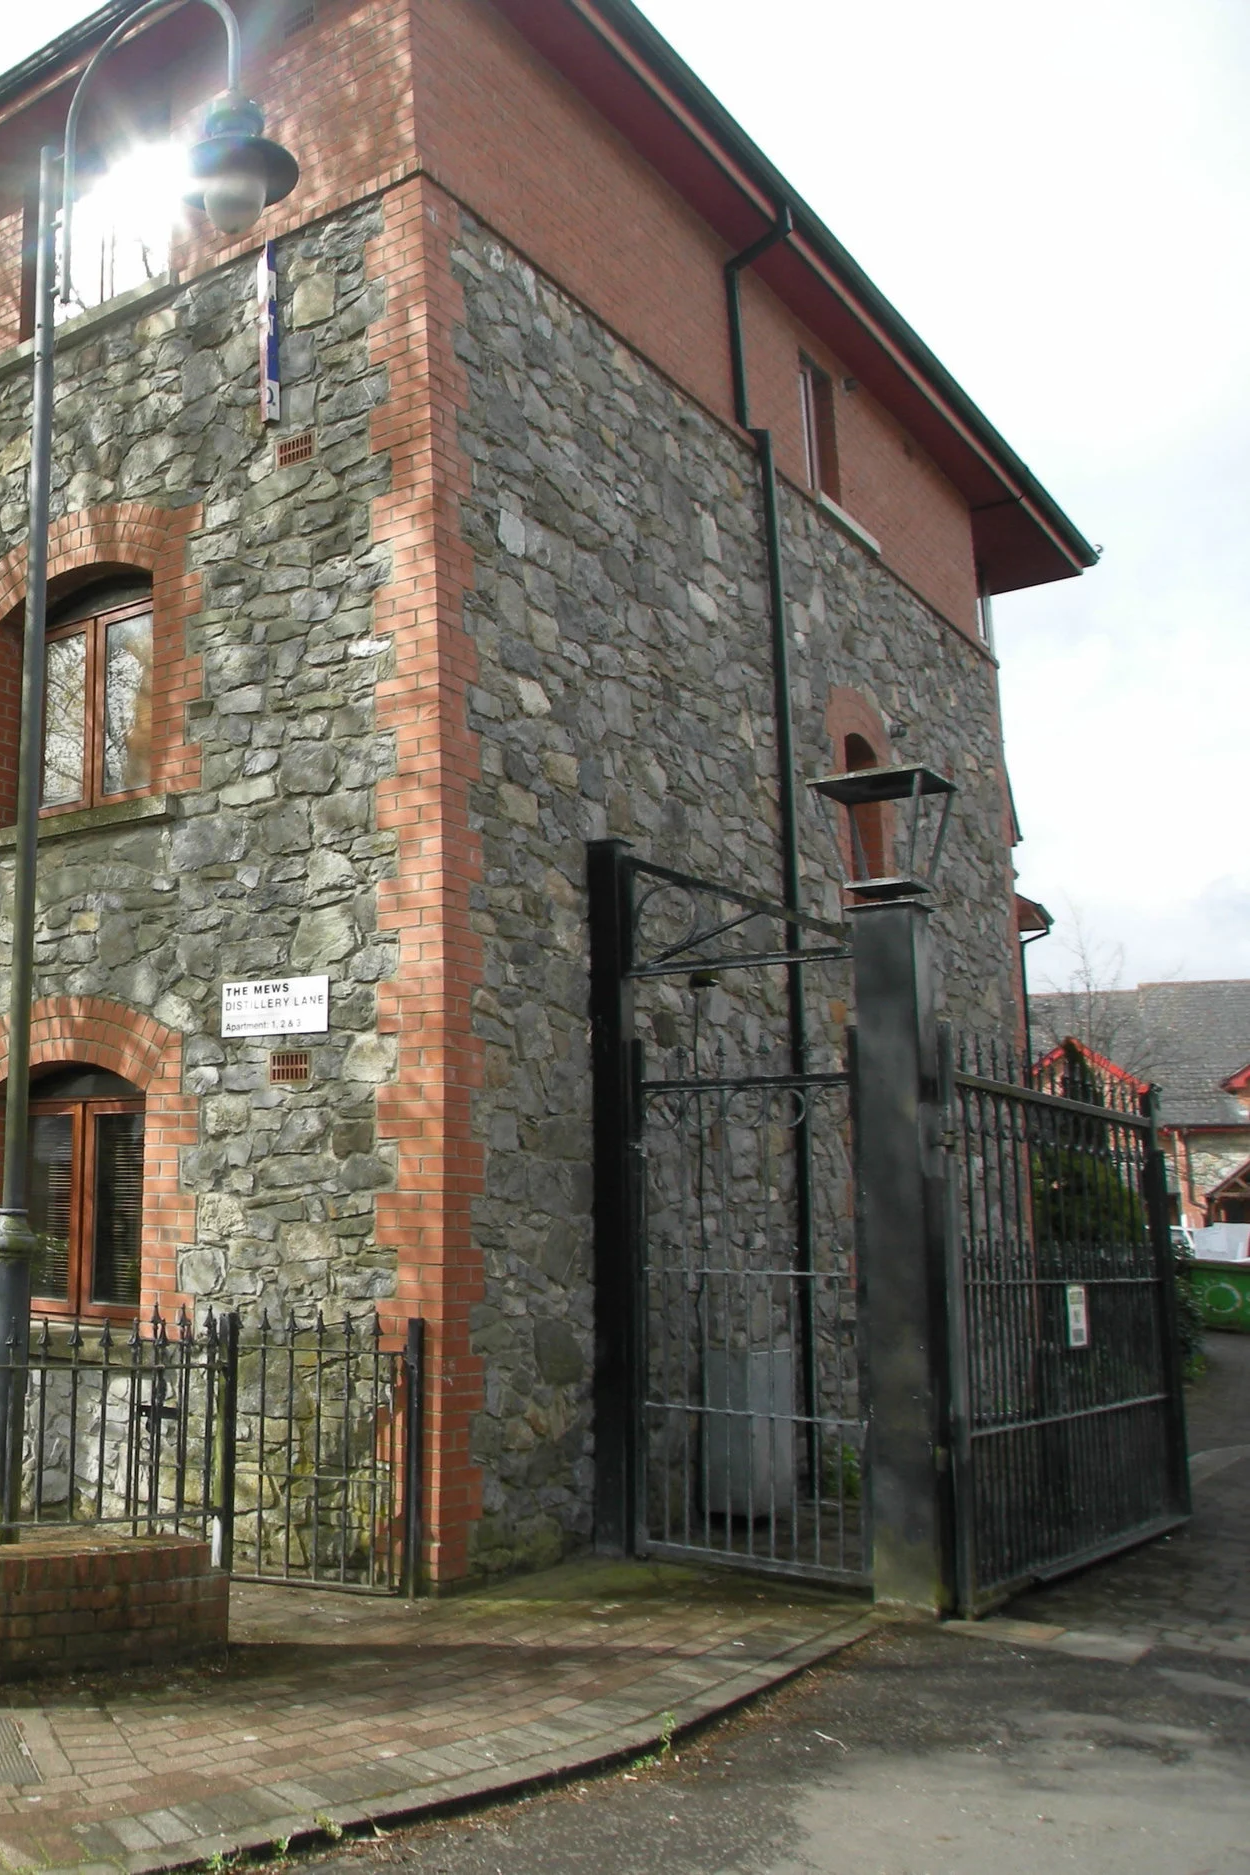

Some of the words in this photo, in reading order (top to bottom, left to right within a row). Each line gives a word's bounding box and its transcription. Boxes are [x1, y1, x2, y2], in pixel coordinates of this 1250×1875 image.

[225, 986, 249, 997] THE
[253, 983, 290, 995] MEWS
[225, 997, 290, 1011] DISTILLERY
[294, 994, 324, 1007] LANE
